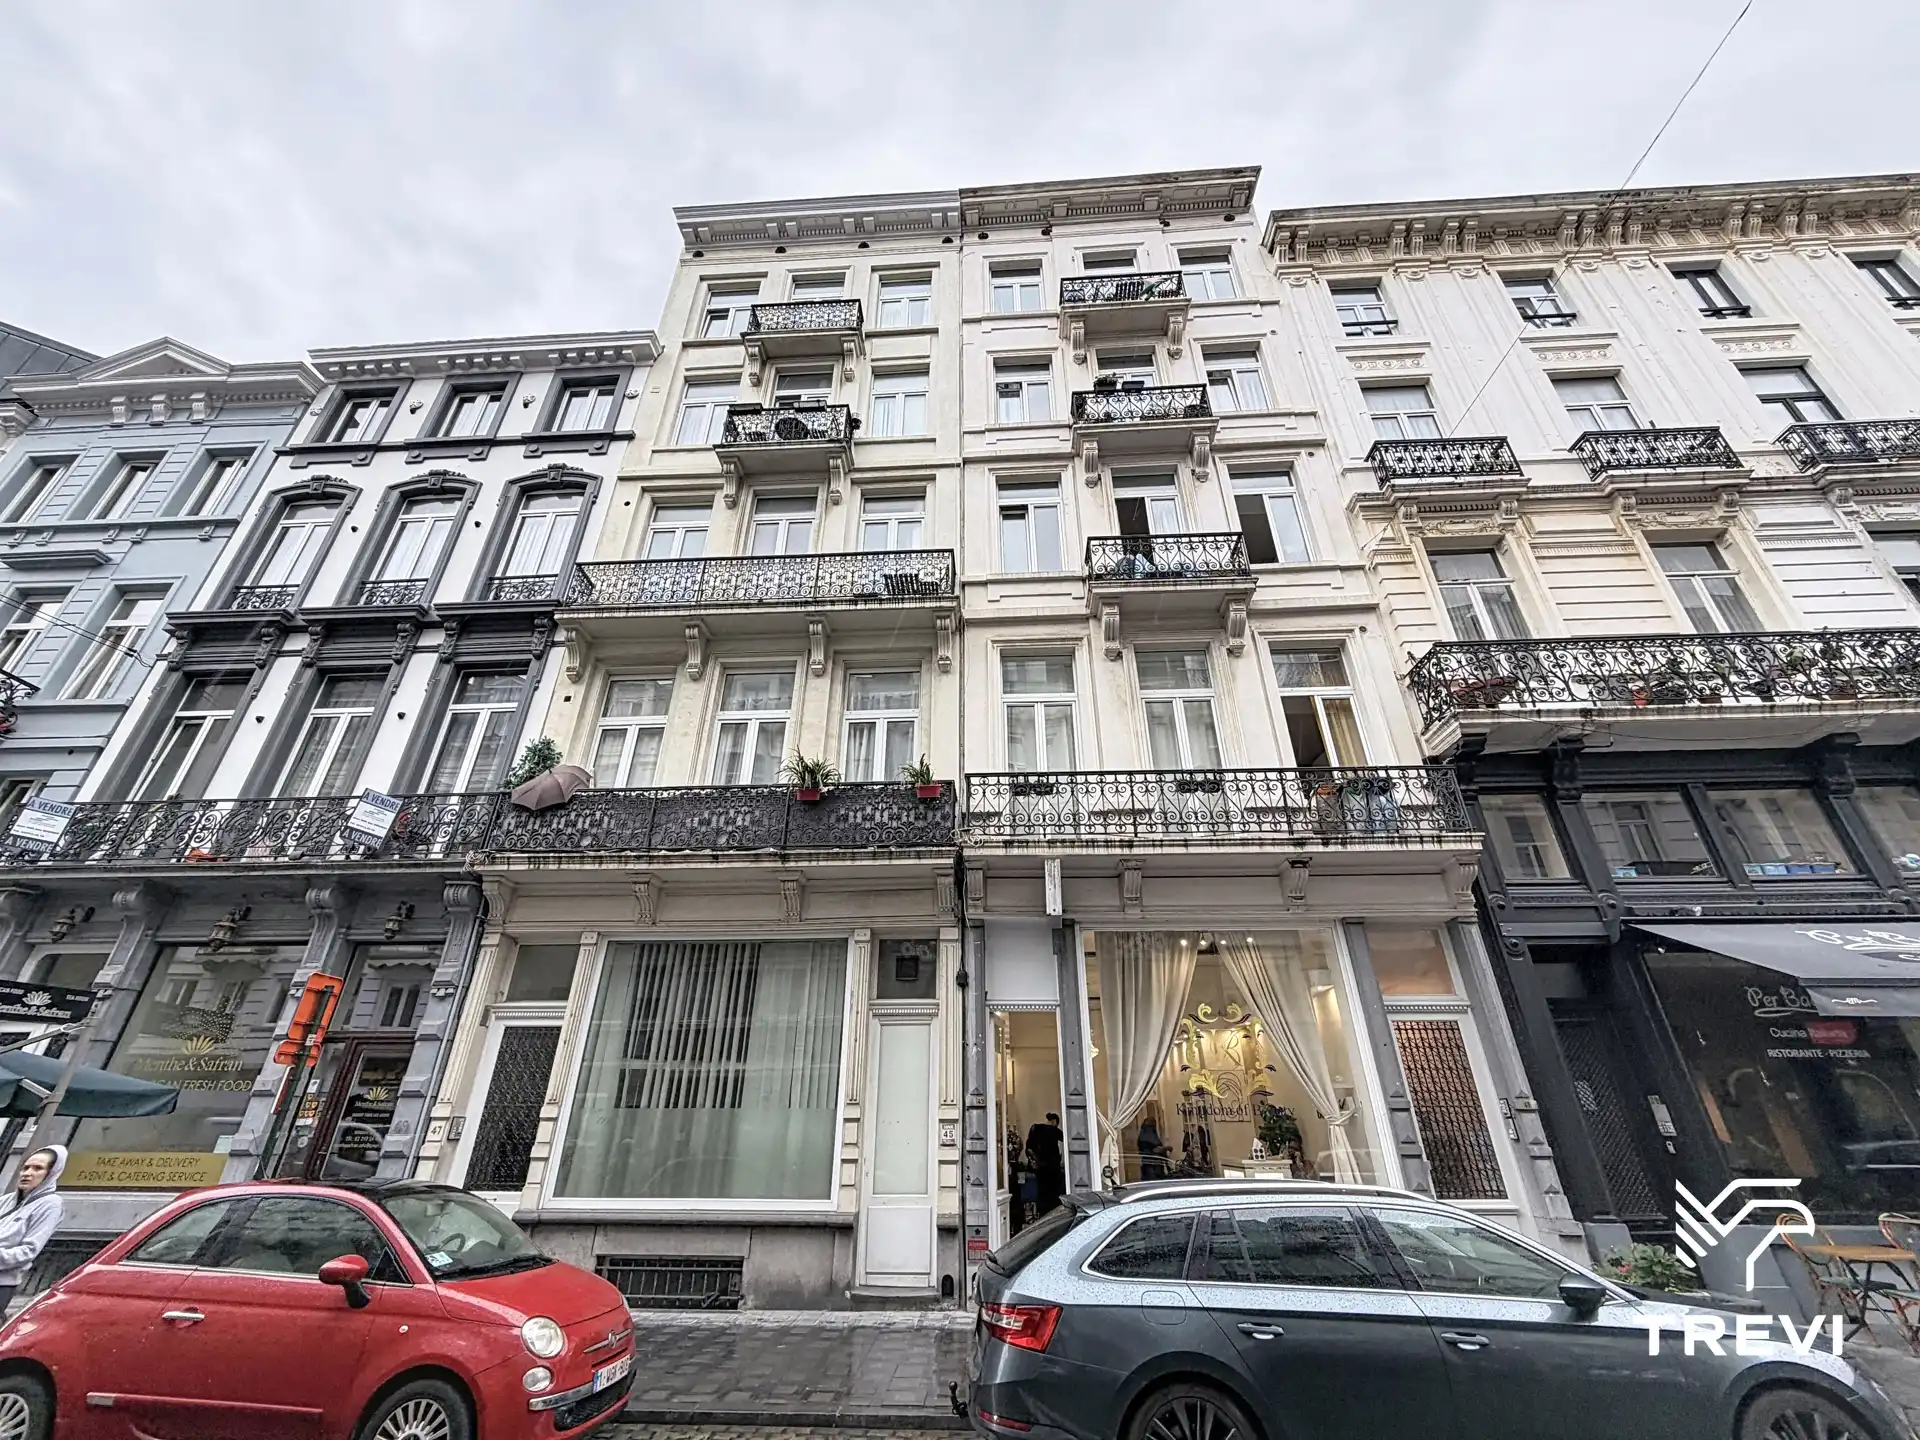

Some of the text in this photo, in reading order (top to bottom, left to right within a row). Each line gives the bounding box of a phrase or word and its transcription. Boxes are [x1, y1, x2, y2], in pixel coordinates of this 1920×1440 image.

[27, 799, 73, 815] A VENDRE
[364, 791, 401, 811] A VENDRE
[4, 836, 54, 852] A VENDRE
[342, 829, 383, 849] A VENDRE
[0, 1002, 28, 1015] enthe
[37, 1006, 72, 1019] Safran
[1769, 1027, 1807, 1039] Cucina
[1766, 1048, 1823, 1059] RISTORANTE
[1829, 1048, 1871, 1059] PIZZERIA
[134, 1056, 244, 1073] Menthe & Safran
[182, 1079, 215, 1092] FRESH
[216, 1079, 253, 1092] FOOD
[430, 1125, 443, 1136] 47
[943, 1130, 954, 1139] 45
[96, 1156, 201, 1169] TAKE AWAY & DELIVERY
[76, 1170, 208, 1183] EVENT & CATERING SERVICE
